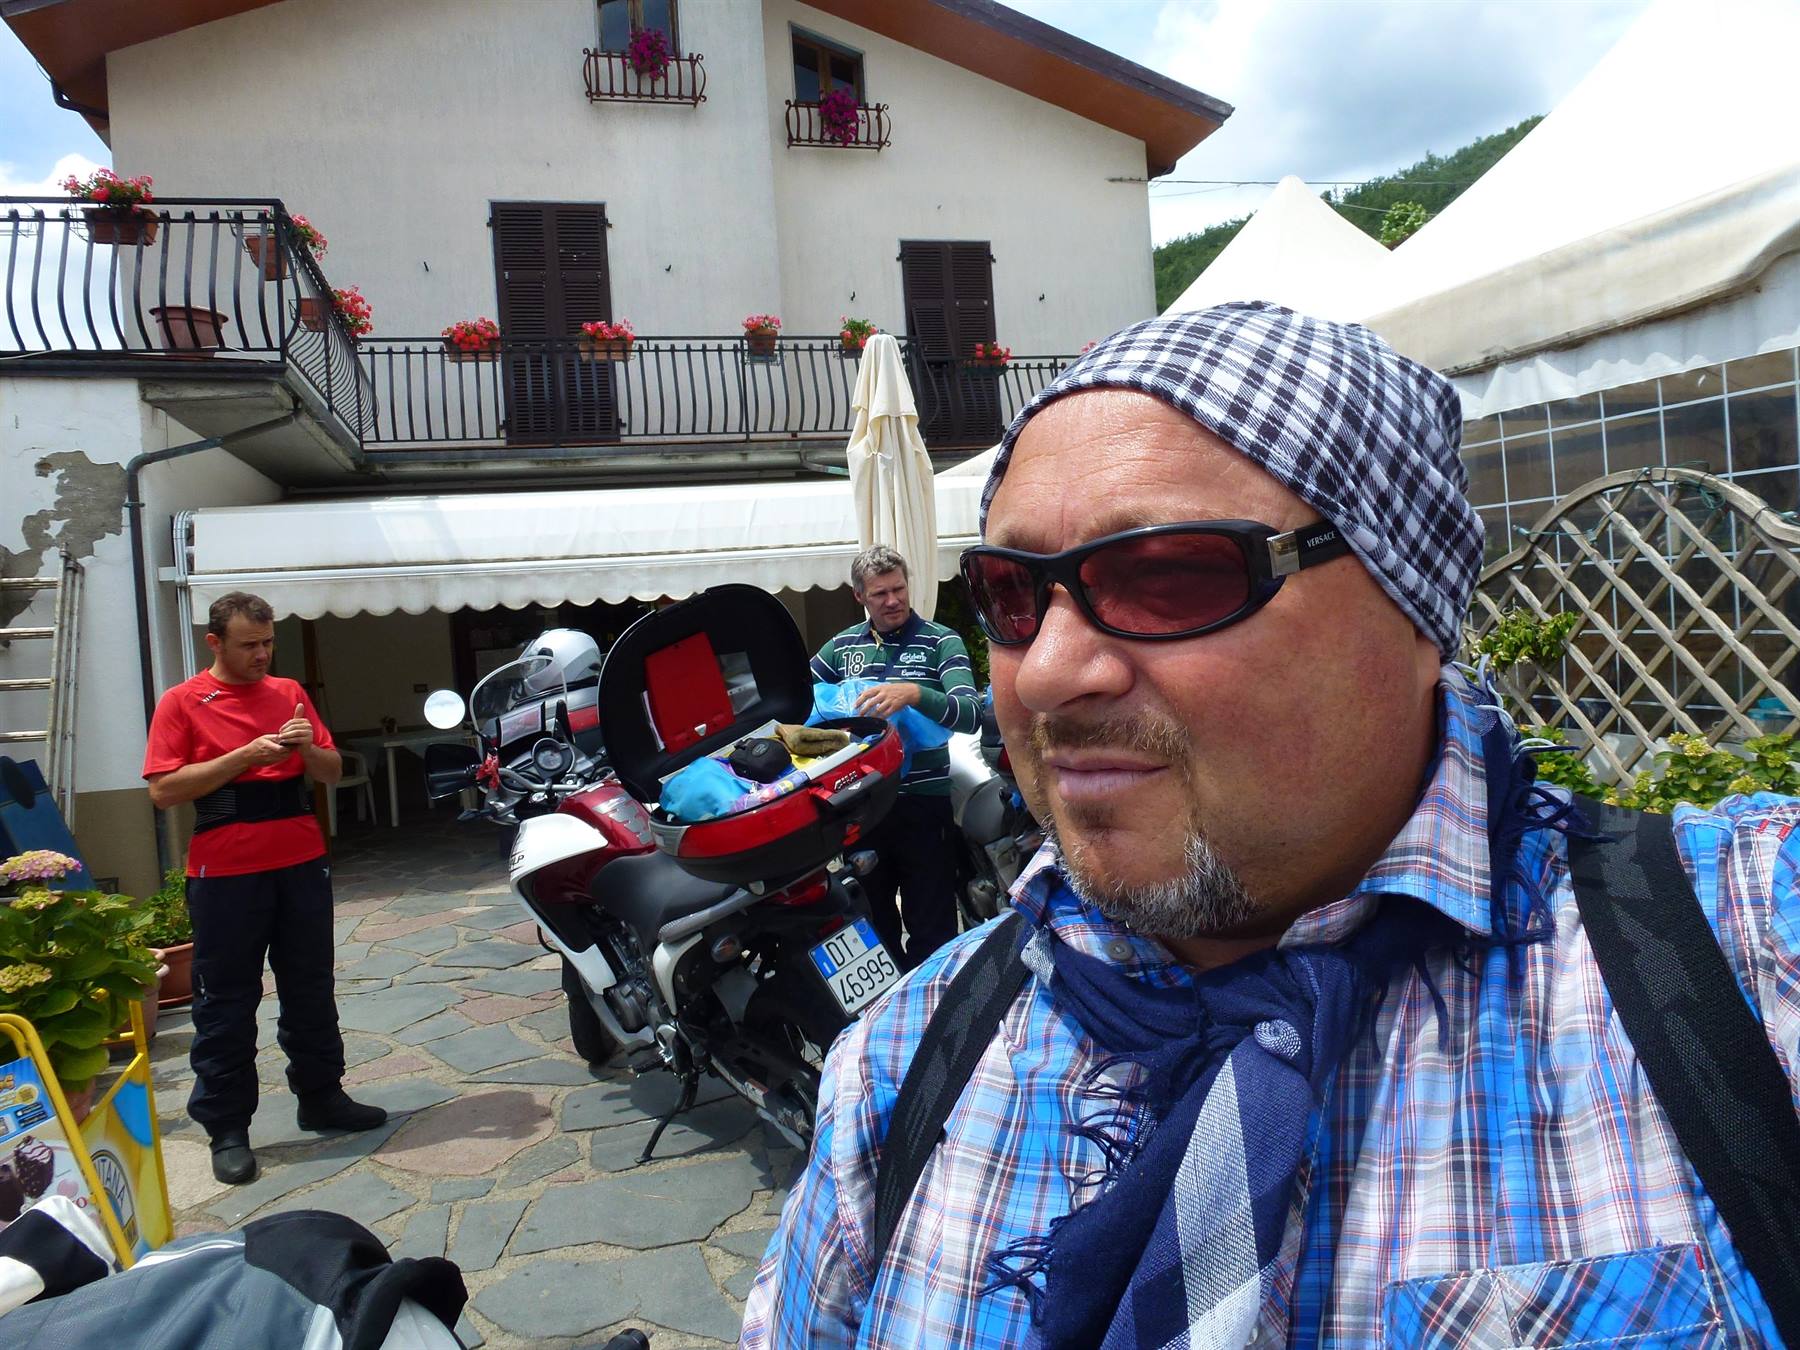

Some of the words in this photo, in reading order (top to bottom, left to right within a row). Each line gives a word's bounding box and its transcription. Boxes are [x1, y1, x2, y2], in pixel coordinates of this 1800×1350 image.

[1306, 531, 1336, 548] VERSACE
[843, 651, 865, 677] 18
[826, 933, 854, 967] DT
[840, 951, 895, 1006] 46995
